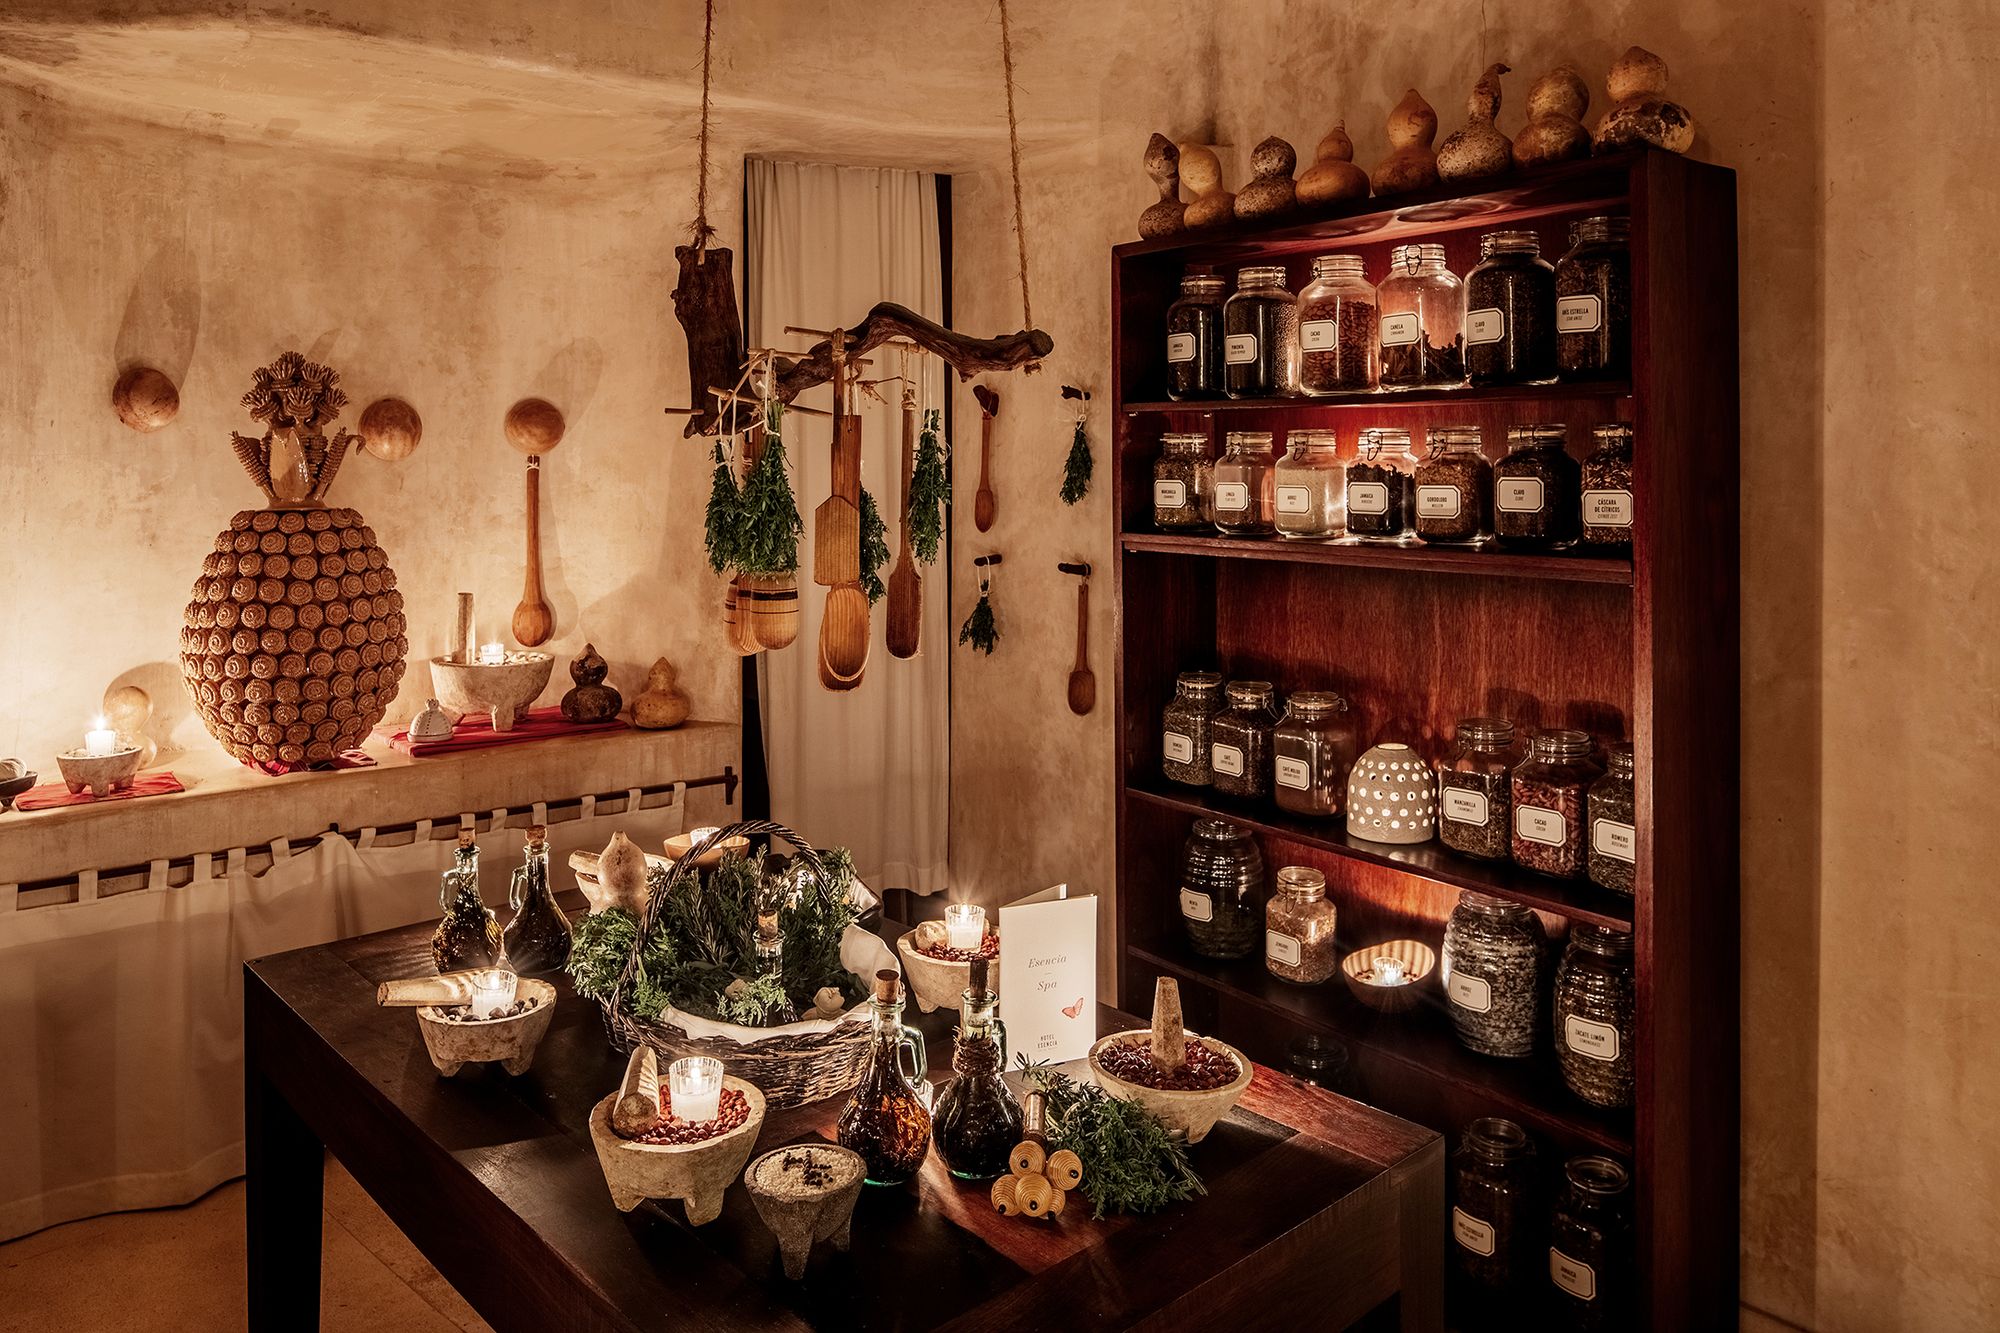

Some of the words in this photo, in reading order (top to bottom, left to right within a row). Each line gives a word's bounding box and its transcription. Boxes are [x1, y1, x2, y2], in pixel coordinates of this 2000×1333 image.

[1454, 799, 1476, 808] MANZANILLA
[1534, 818, 1547, 826] CACAO
[1611, 833, 1629, 843] ROMERO
[1028, 954, 1067, 969] Esencia
[1037, 981, 1057, 992] Spa
[1575, 1029, 1590, 1039] ZACATE
[1590, 1033, 1605, 1042] LIMÓN
[1037, 1041, 1058, 1049] ESENCIA
